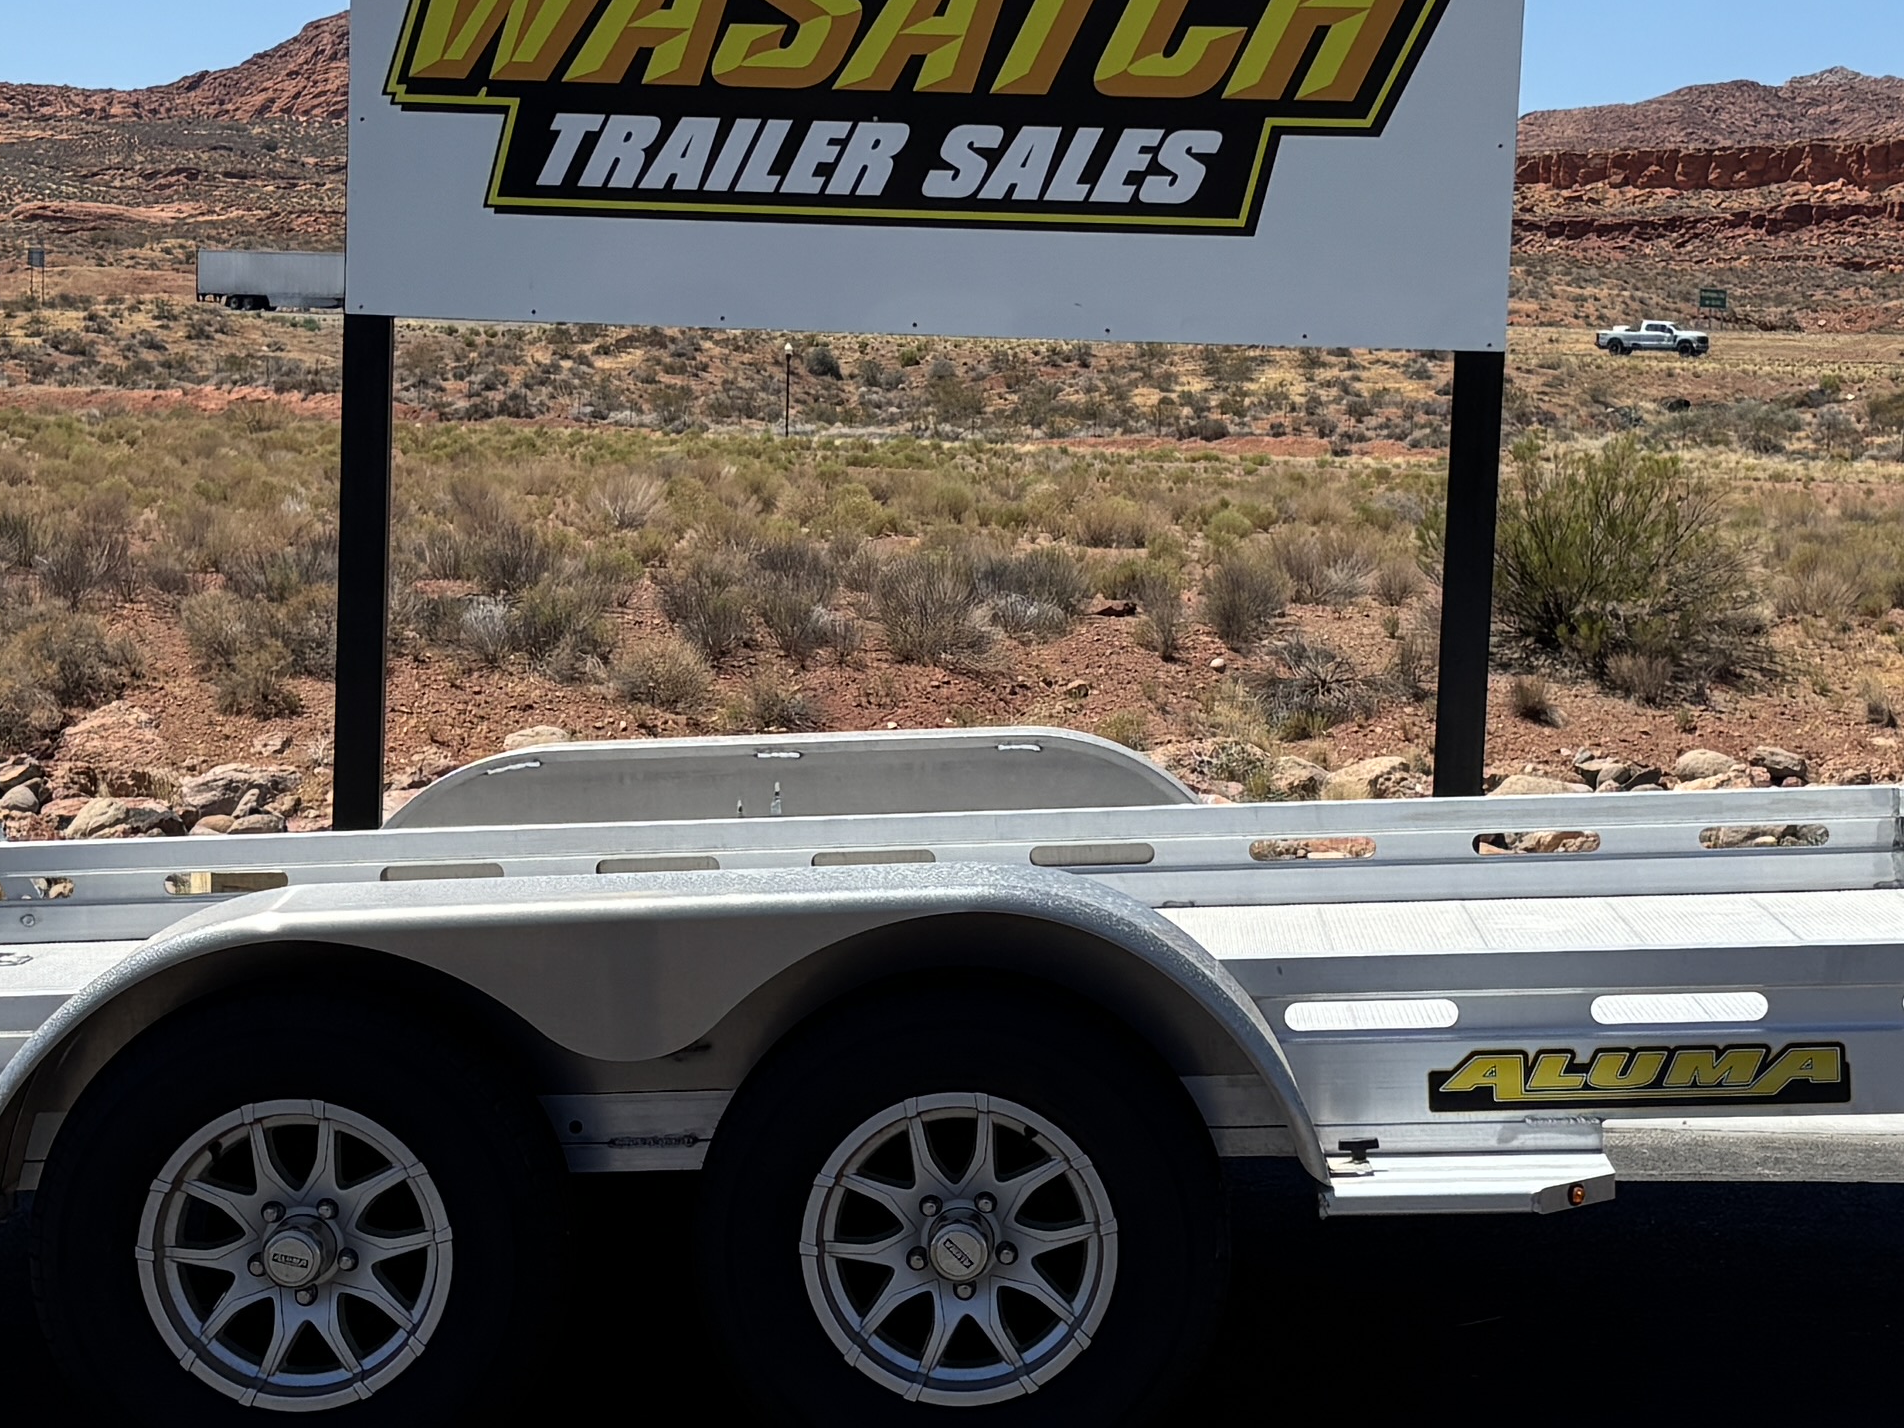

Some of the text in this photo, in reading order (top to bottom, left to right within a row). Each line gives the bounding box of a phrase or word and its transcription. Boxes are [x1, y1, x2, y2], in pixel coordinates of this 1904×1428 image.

[534, 113, 1224, 205] TRAILER SALES
[1439, 1048, 1840, 1102] ALUMA
